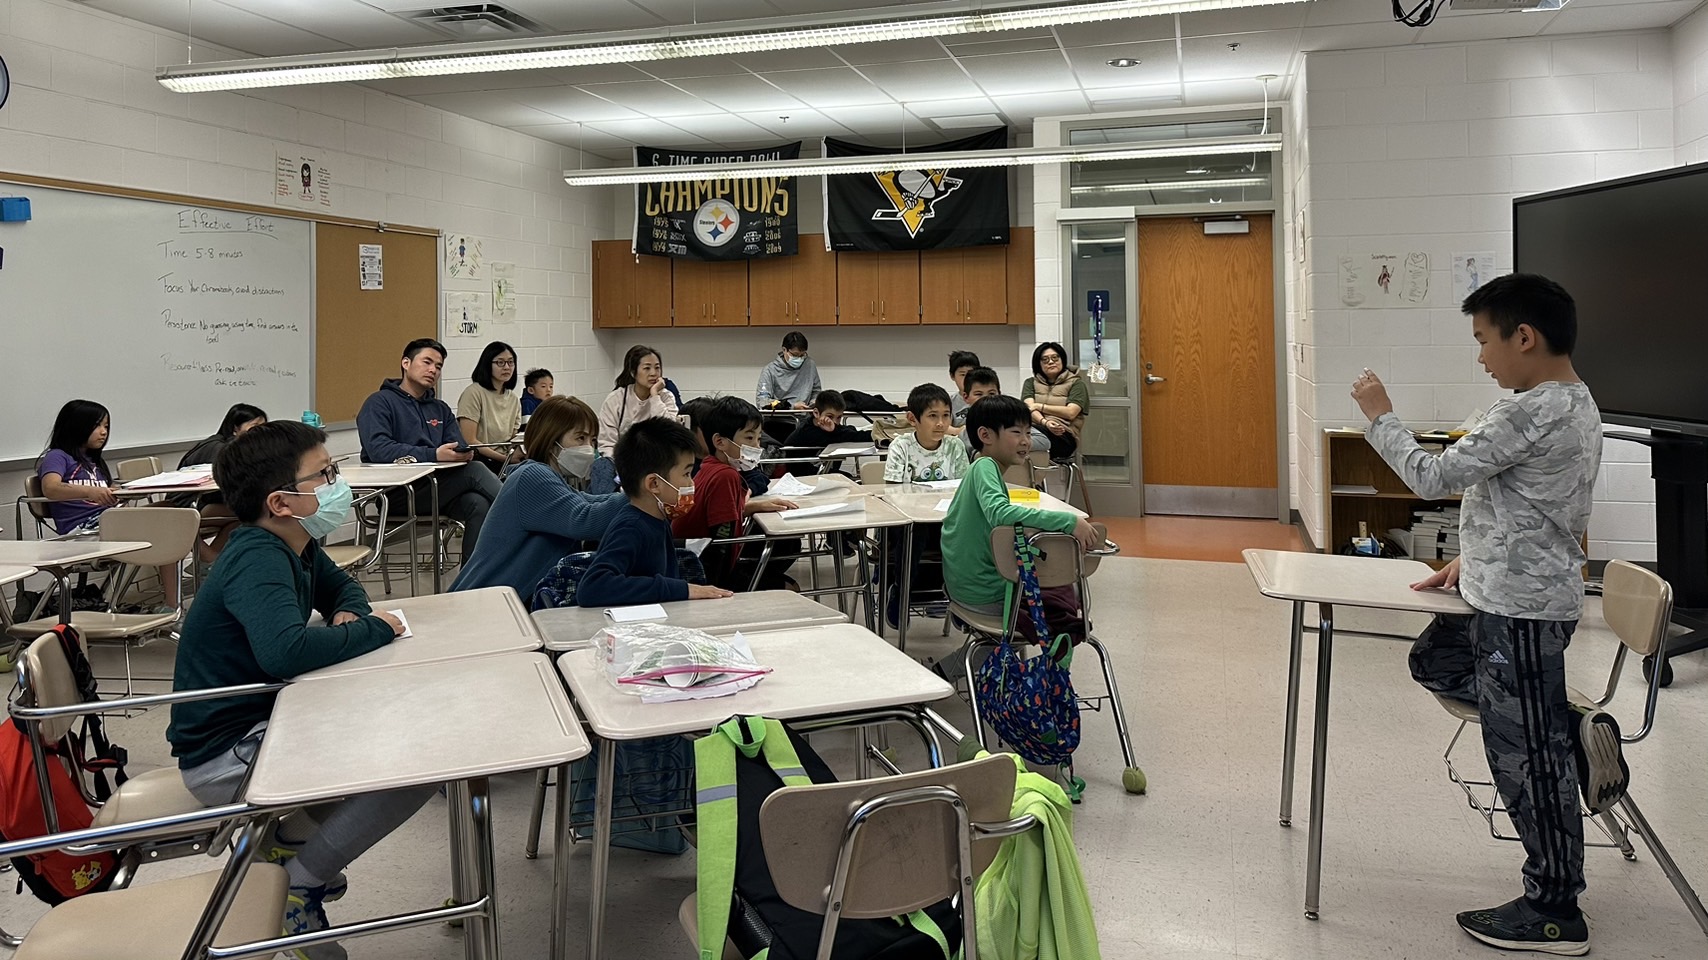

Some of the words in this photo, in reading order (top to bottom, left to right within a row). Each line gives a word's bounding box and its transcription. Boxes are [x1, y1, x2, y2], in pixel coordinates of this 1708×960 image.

[178, 209, 232, 229] Effective
[246, 215, 275, 232] Effort
[157, 240, 188, 258] Time
[157, 272, 184, 294] Focus
[459, 322, 478, 334] STORM
